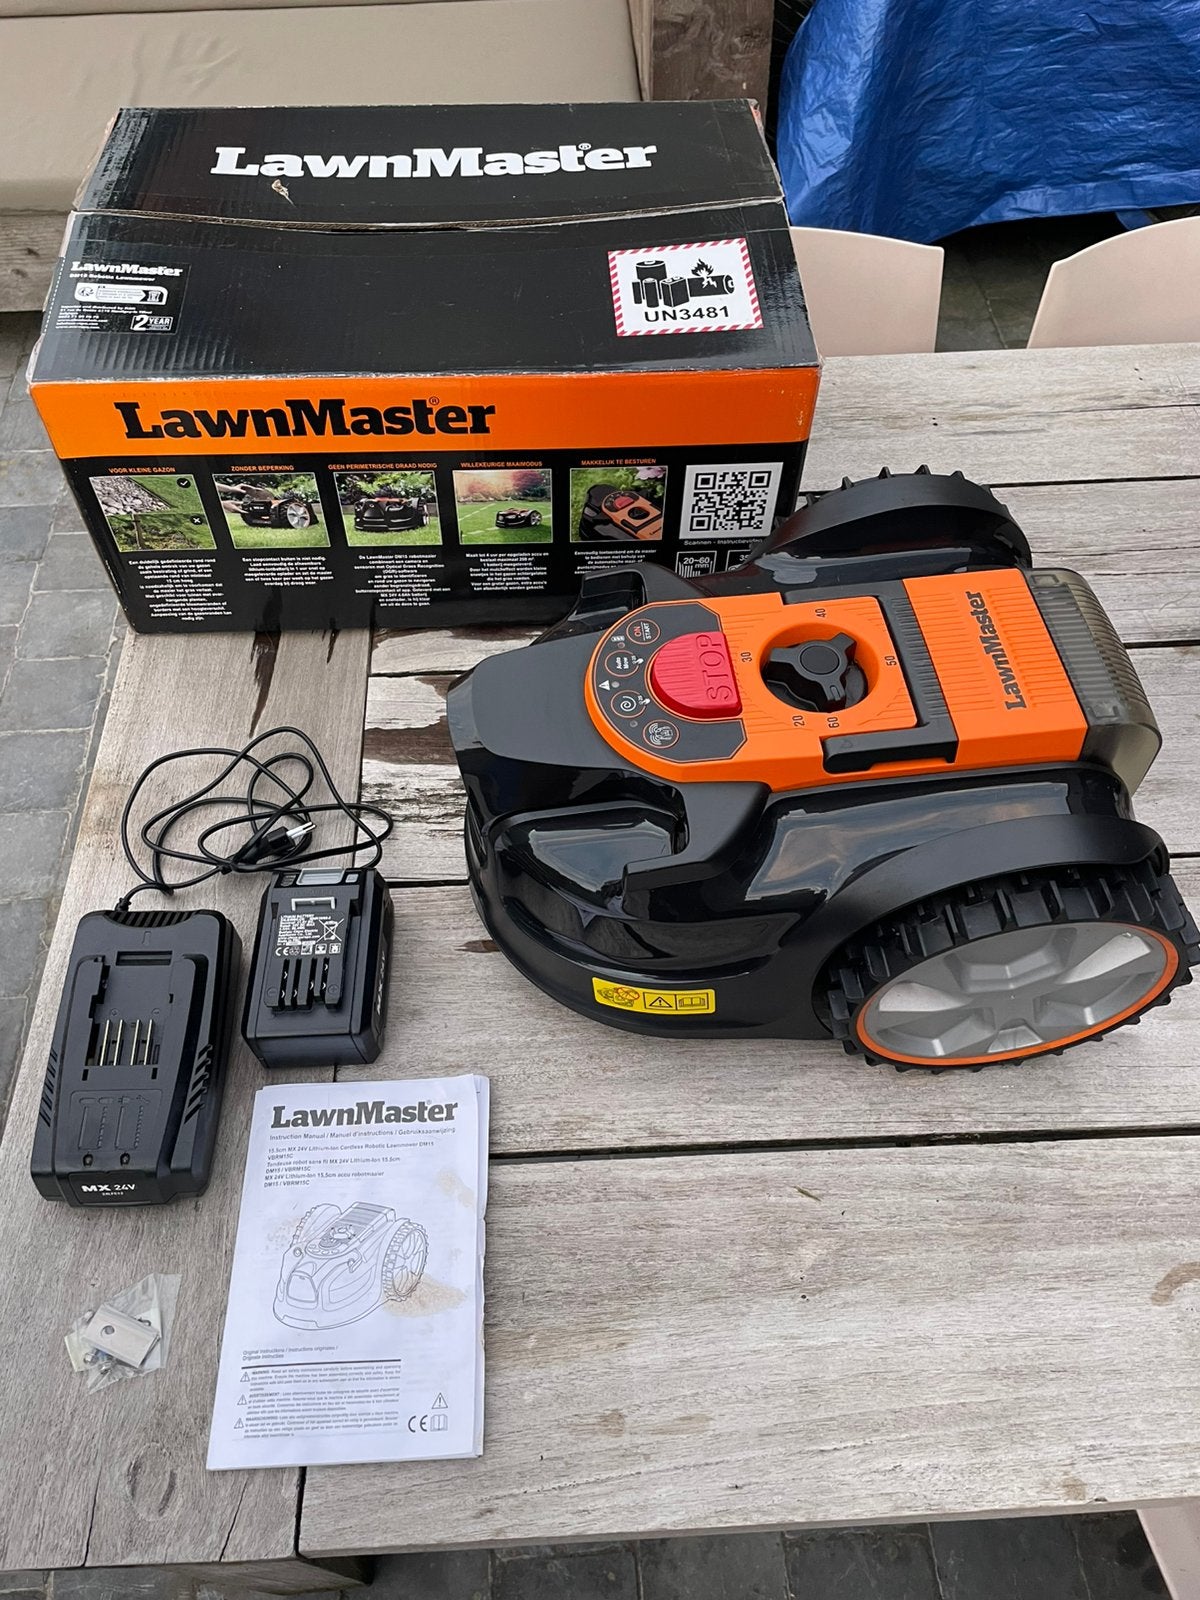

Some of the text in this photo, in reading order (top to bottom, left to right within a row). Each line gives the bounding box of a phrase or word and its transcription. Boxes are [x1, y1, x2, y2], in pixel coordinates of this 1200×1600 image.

[210, 143, 657, 178] LawnMaster
[71, 262, 183, 277] LawnMaster
[644, 306, 730, 322] UN3481
[134, 315, 148, 331] 2
[114, 397, 496, 439] LawnMaster
[816, 608, 826, 618] 40
[634, 626, 642, 637] ON
[643, 623, 652, 640] START
[741, 652, 752, 662] 30
[966, 591, 1027, 710] LawnMaster
[696, 634, 733, 700] STOP
[885, 655, 897, 666] 50
[793, 715, 805, 726] 20
[828, 717, 840, 728] 60
[271, 1100, 458, 1128] LawnMaster
